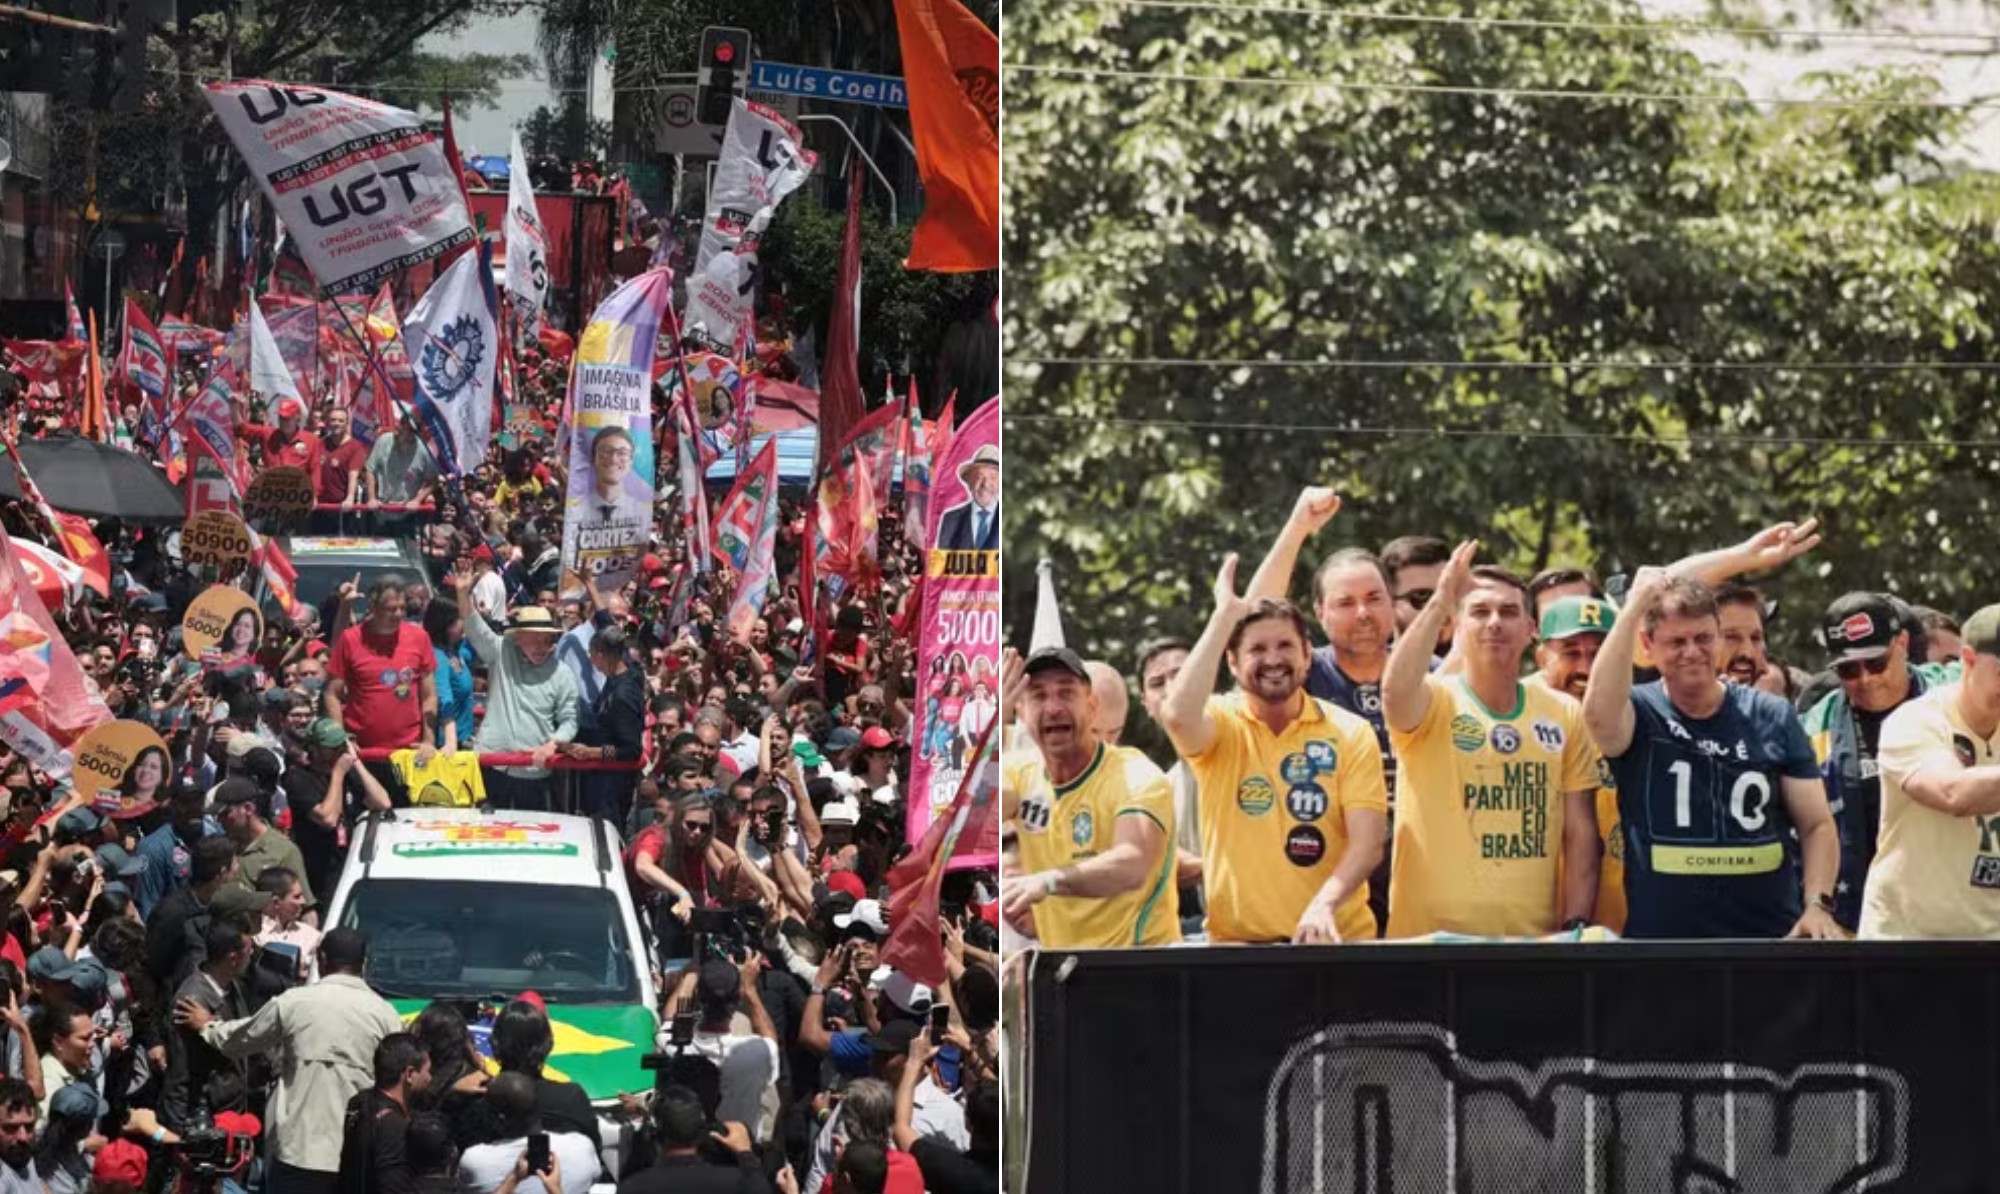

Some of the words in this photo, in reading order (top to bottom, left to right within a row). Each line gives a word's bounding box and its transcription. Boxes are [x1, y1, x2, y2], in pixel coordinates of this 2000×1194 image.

[757, 66, 817, 92] Luís
[828, 76, 904, 102] Coelh
[276, 166, 299, 181] UGT
[301, 156, 323, 171] UGT
[326, 145, 348, 160] UGT
[349, 138, 371, 151] UGT
[301, 163, 421, 227] UGT
[319, 227, 363, 248] UNIÃO
[327, 280, 350, 295] UGT
[352, 270, 376, 286] UGT
[378, 259, 400, 275] UGT
[402, 252, 426, 266] UGT
[427, 241, 451, 256] UGT
[453, 227, 474, 244] UGT
[585, 369, 641, 389] IMAGINA
[182, 529, 249, 554] 50900
[1580, 600, 1600, 625] R
[186, 616, 222, 638] 5000
[937, 609, 997, 646] 5000
[78, 753, 121, 780] 5000
[1504, 762, 1547, 786] MEU
[1241, 785, 1272, 801] 222
[1291, 790, 1325, 813] 111
[1464, 784, 1547, 810] PARTIDO
[1021, 800, 1050, 827] 111
[1482, 833, 1547, 858] BRASIL
[1685, 856, 1754, 866] CONFIRMA
